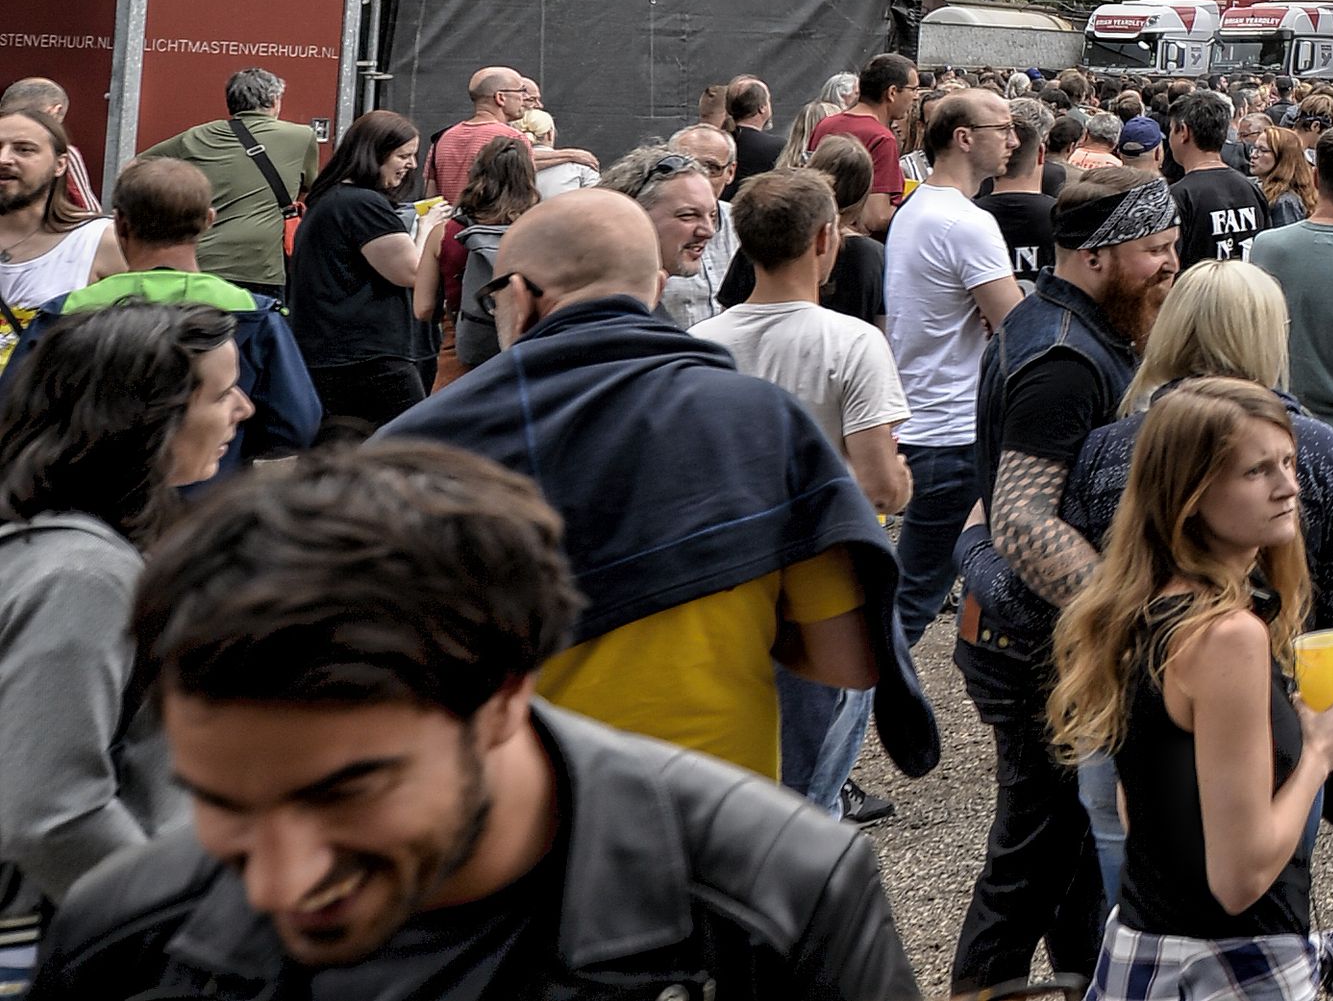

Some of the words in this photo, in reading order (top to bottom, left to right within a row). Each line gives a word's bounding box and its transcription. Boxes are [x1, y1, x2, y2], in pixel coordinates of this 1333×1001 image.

[0, 33, 113, 50] STENVERHUUR.NL
[143, 38, 340, 59] LICHTMASTENVERHUUR.NL
[1209, 206, 1258, 236] FAN
